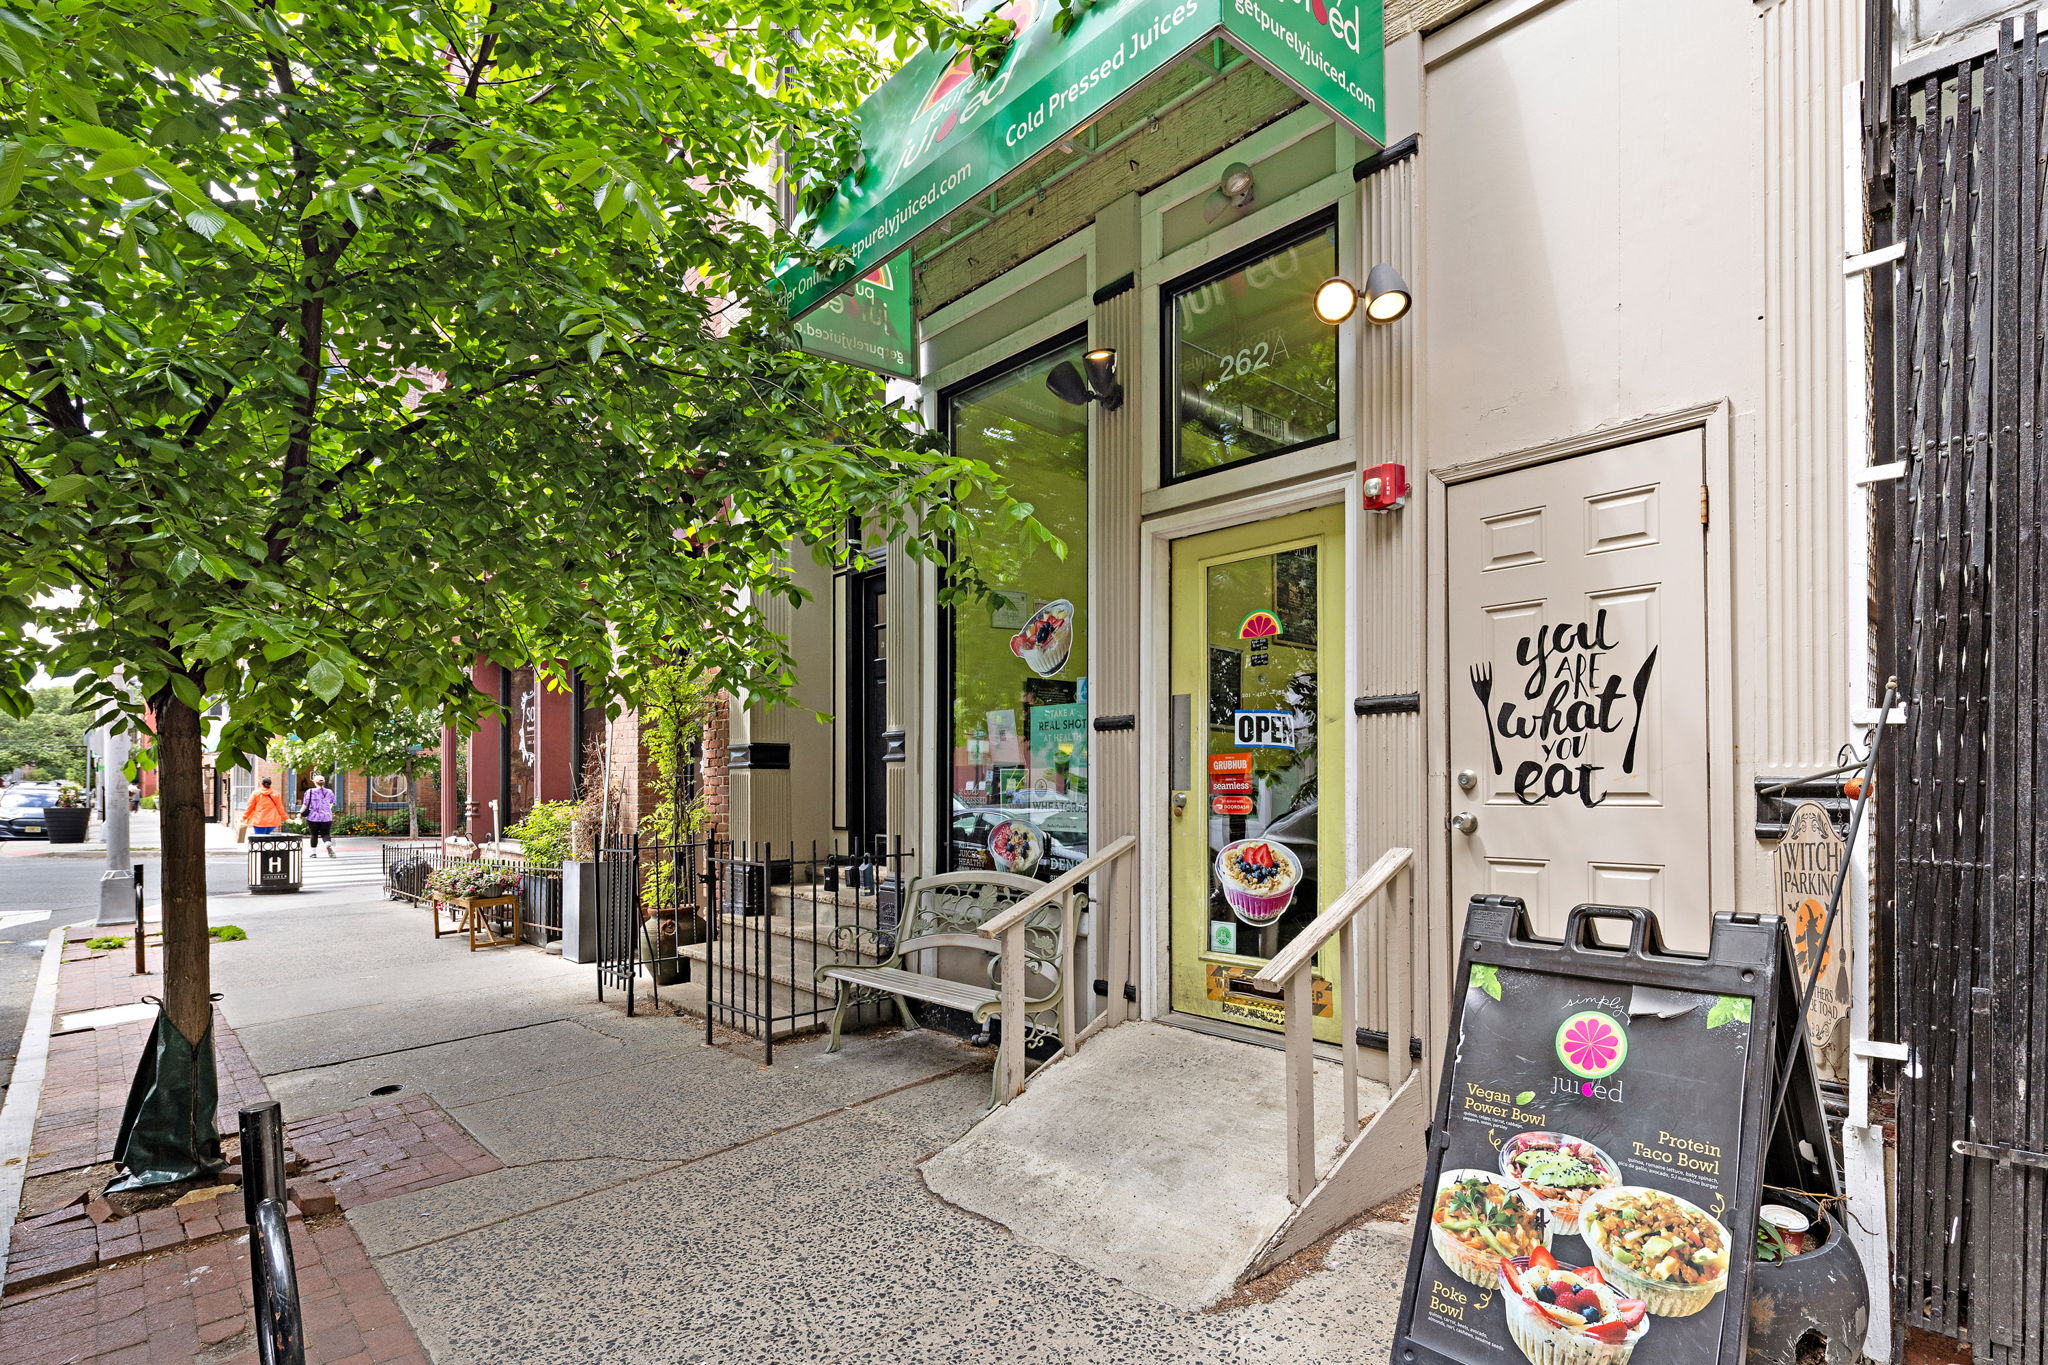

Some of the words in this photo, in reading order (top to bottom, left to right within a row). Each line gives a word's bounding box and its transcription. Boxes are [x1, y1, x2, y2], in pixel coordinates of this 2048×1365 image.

[1234, 0, 1376, 112] getpurelyjuiced.com
[1005, 108, 1044, 147] Cold
[1049, 43, 1125, 119] Pressed
[1128, 0, 1198, 59] Juices
[838, 163, 972, 272] gtpurelyjuiced.com
[1516, 608, 1620, 700] you
[1554, 653, 1607, 699] ARE
[1497, 675, 1627, 741] what
[1038, 720, 1061, 731] REAL
[1238, 715, 1293, 745] OPEN
[1213, 760, 1247, 770] GRUBHUB
[1213, 781, 1250, 790] seamless
[1515, 761, 1608, 809] eat
[1783, 842, 1839, 872] WITCH
[1813, 986, 1834, 1003] THERS
[1561, 994, 1631, 1026] simply
[1466, 1082, 1512, 1104] Vegan
[1464, 1097, 1508, 1118] Power
[1511, 1107, 1546, 1127] Bowl
[1632, 1141, 1673, 1163] Taco
[1676, 1152, 1720, 1175] Bowl
[1658, 1130, 1722, 1158] Protein
[1432, 1280, 1468, 1305] Poke
[1430, 1296, 1464, 1321] Bowl
